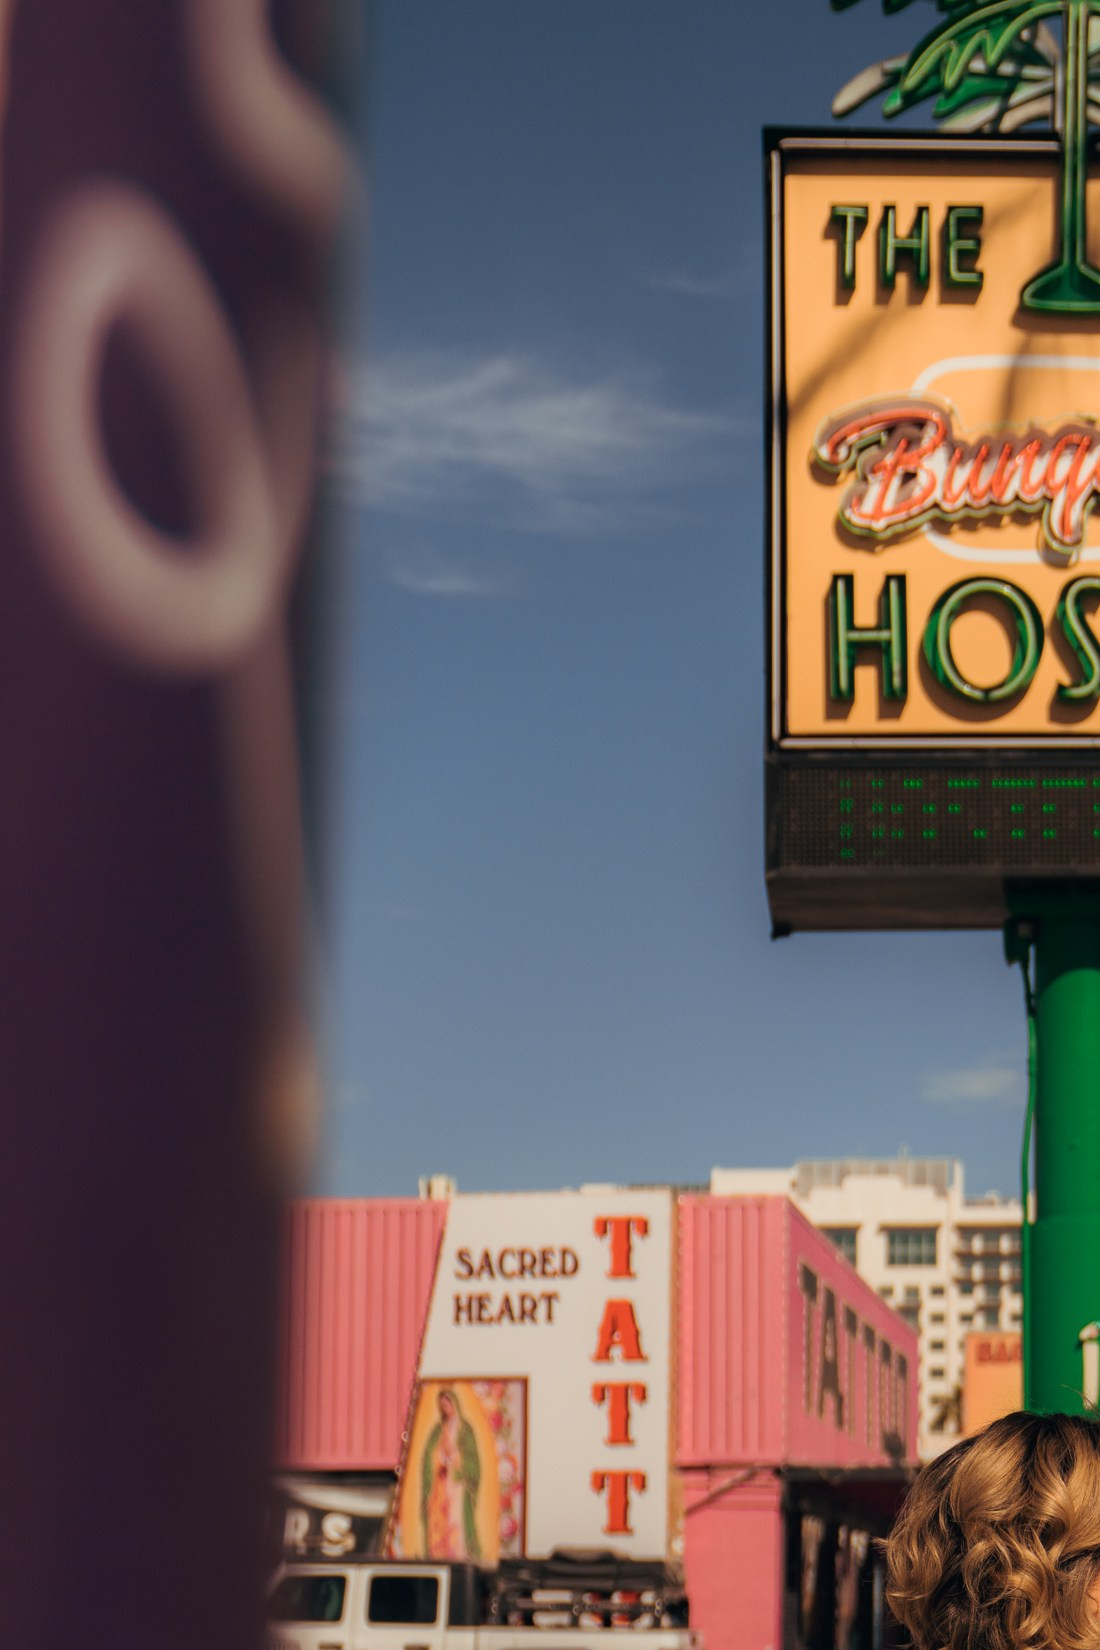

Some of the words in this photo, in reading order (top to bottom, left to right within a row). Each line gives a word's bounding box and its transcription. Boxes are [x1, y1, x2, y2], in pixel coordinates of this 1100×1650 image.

[831, 204, 984, 289] THE
[454, 1247, 580, 1280] SACRED
[453, 1292, 560, 1325] HEART
[590, 1216, 649, 1537] TATT
